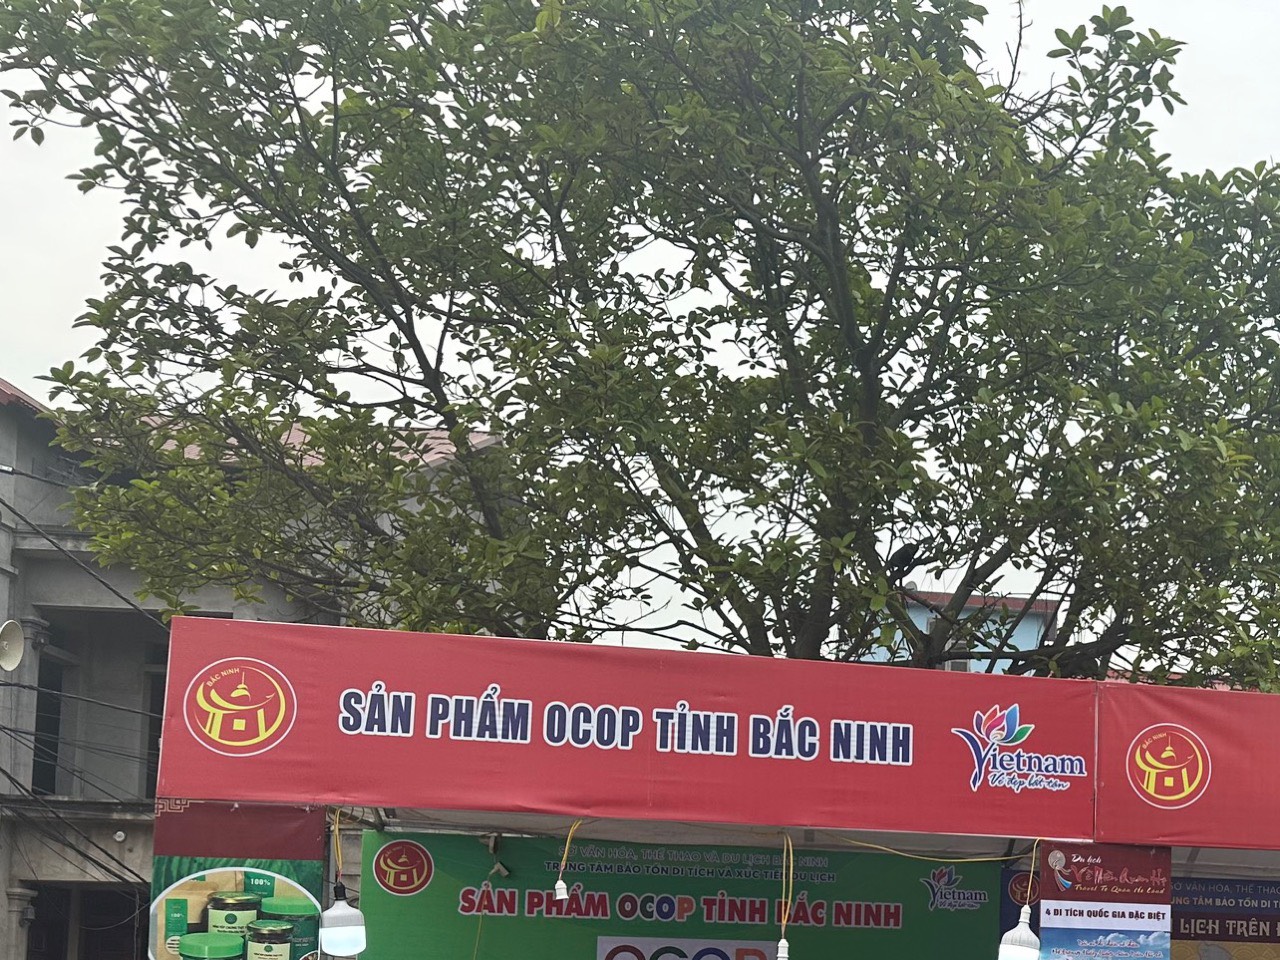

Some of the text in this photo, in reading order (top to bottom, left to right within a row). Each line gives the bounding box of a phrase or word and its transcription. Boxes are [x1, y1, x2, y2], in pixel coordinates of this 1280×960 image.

[221, 668, 240, 677] NINH
[338, 680, 913, 766] SẢN PHẨM OCOP TỈNH BẮC NINH
[951, 728, 1087, 791] Vietnam
[250, 878, 271, 886] 100%
[589, 861, 613, 873] TÂM
[672, 866, 684, 876] DI
[685, 866, 714, 877] TÍCH
[717, 867, 732, 878] VÀ
[735, 867, 761, 879] XÚC
[810, 872, 836, 884] LỊCH
[920, 876, 989, 911] Vietnam
[1075, 884, 1098, 892] Travel
[458, 880, 903, 929] SẢN PHẨM OCOP TỈNH BẮC NINH
[1192, 895, 1213, 906] TÂM
[1260, 899, 1271, 908] DI
[1045, 907, 1166, 921] 4 DI TÍCH QUỐC GIA ĐẶC BIỆT
[1179, 917, 1220, 936] LỊCH
[1225, 917, 1271, 938] TRÊN
